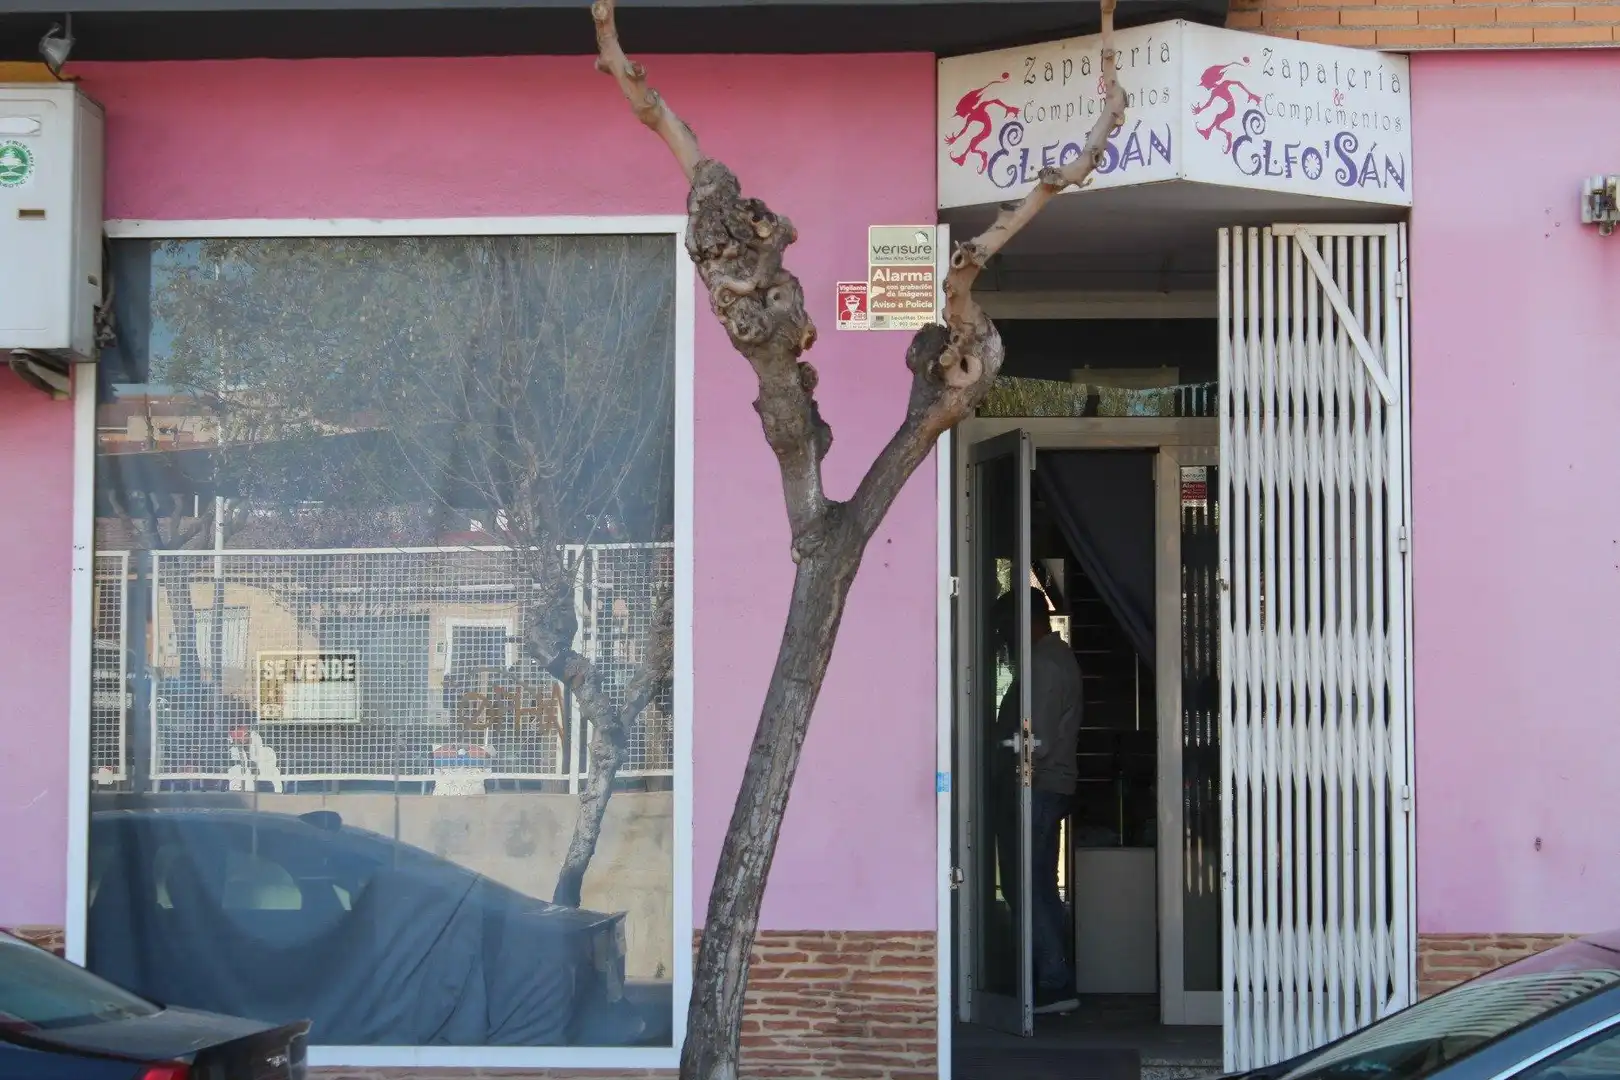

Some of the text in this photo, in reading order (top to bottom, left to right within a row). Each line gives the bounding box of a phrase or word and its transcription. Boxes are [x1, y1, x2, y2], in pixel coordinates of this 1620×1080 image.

[1263, 48, 1401, 93] Zapatería
[1024, 87, 1170, 124] Complentos
[1333, 88, 1345, 107] &
[1264, 93, 1403, 132] Complementos
[1232, 109, 1405, 192] ELFO'SÁN
[872, 245, 932, 255] verisure
[873, 268, 933, 282] Alarma
[872, 301, 896, 309] Aviso
[905, 301, 933, 309] Policía
[263, 659, 356, 680] SE VENDE
